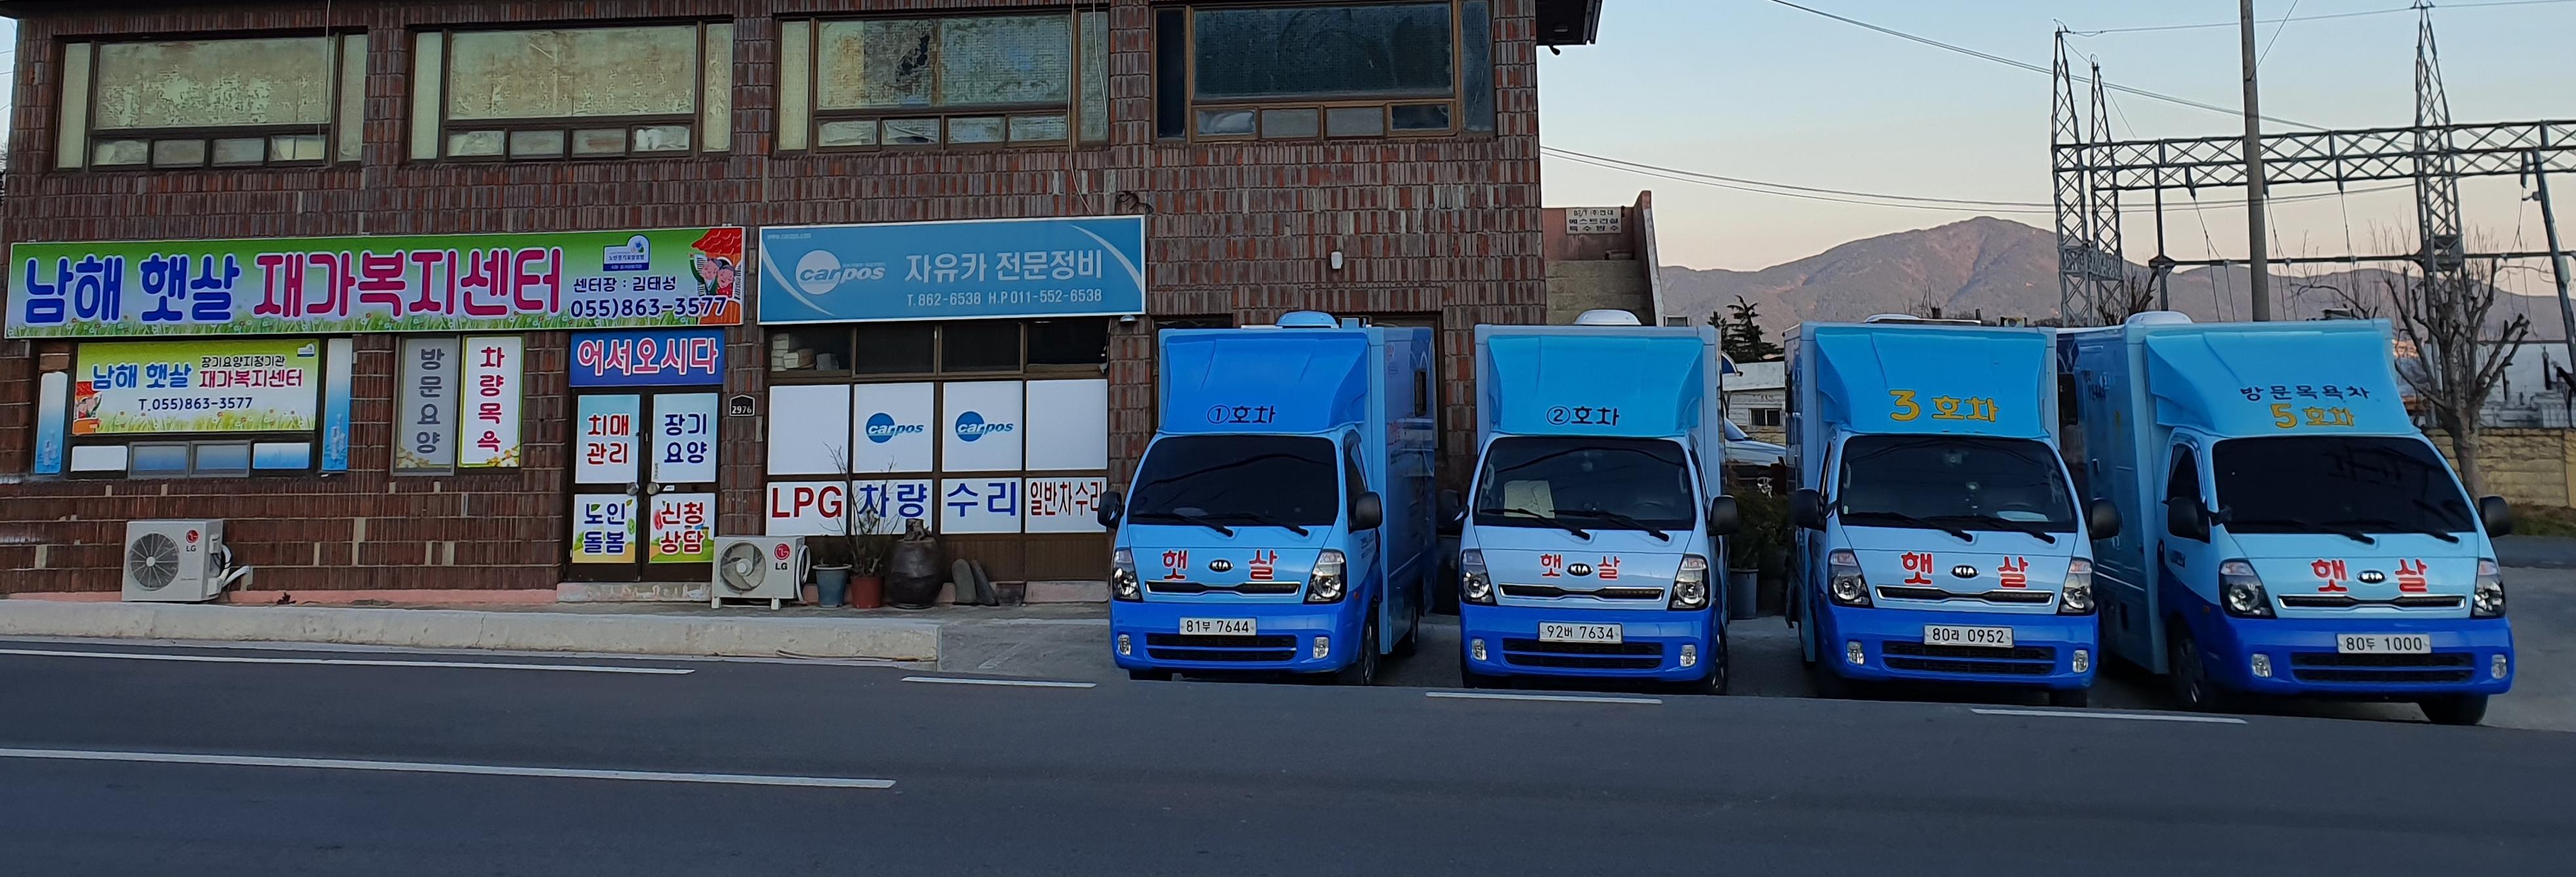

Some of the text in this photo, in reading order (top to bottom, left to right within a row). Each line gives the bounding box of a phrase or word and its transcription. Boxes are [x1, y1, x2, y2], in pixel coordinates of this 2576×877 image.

[800, 266, 886, 284] carpos
[904, 248, 1102, 283] 자유카 전문정비
[25, 248, 563, 324] 남해 햇살 재가복지센터
[573, 277, 617, 294] 센터장
[632, 275, 676, 292] 김태성
[571, 296, 727, 319] 055)863-3577
[201, 356, 286, 369] 장기요양지정기관
[577, 337, 718, 377] 어서오시다
[92, 363, 304, 390] 남해 햇살 재가복지센터
[138, 396, 253, 412] T.055)863-3577
[416, 347, 445, 455] 방문요양
[476, 346, 505, 453] 차량목욕
[2239, 385, 2371, 401] 방문목욕차
[731, 405, 752, 415] 2976
[1889, 389, 2000, 422] 3 호차
[588, 414, 630, 436] 치매
[664, 413, 707, 436] 장기
[868, 422, 924, 438] carpos
[956, 421, 1014, 436] carpos
[586, 442, 628, 464] 관리
[664, 441, 707, 464] 요양
[771, 485, 843, 519] LPG
[946, 481, 1016, 518] 수리
[1030, 480, 1103, 517] 일반차수리
[584, 502, 625, 525] 노인
[661, 502, 704, 525] 신청
[583, 531, 625, 554] 돌봄
[660, 530, 704, 554] 상담
[775, 562, 788, 571] LG
[1955, 567, 1976, 576] KIA
[1186, 619, 1249, 634] 81부 7644
[1546, 625, 1614, 640] 92버 7634
[1932, 627, 2004, 643] 80라 0952
[2345, 636, 2423, 651] 80두 1000
